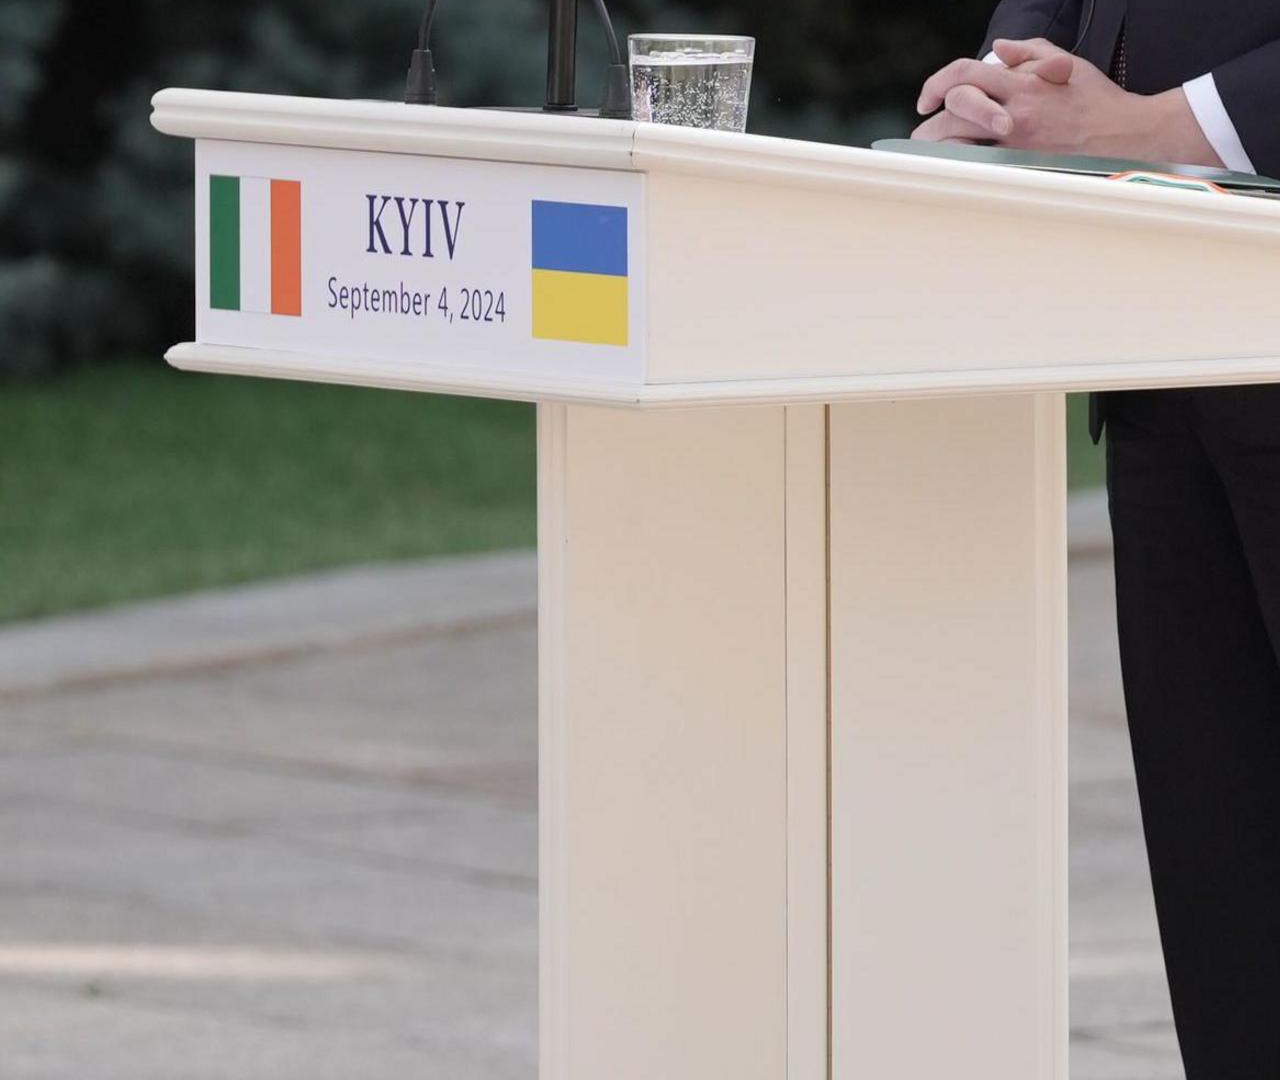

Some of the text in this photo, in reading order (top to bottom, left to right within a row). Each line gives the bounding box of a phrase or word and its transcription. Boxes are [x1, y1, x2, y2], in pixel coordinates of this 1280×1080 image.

[365, 193, 466, 261] KYIV
[327, 275, 507, 324] September 4, 2024
